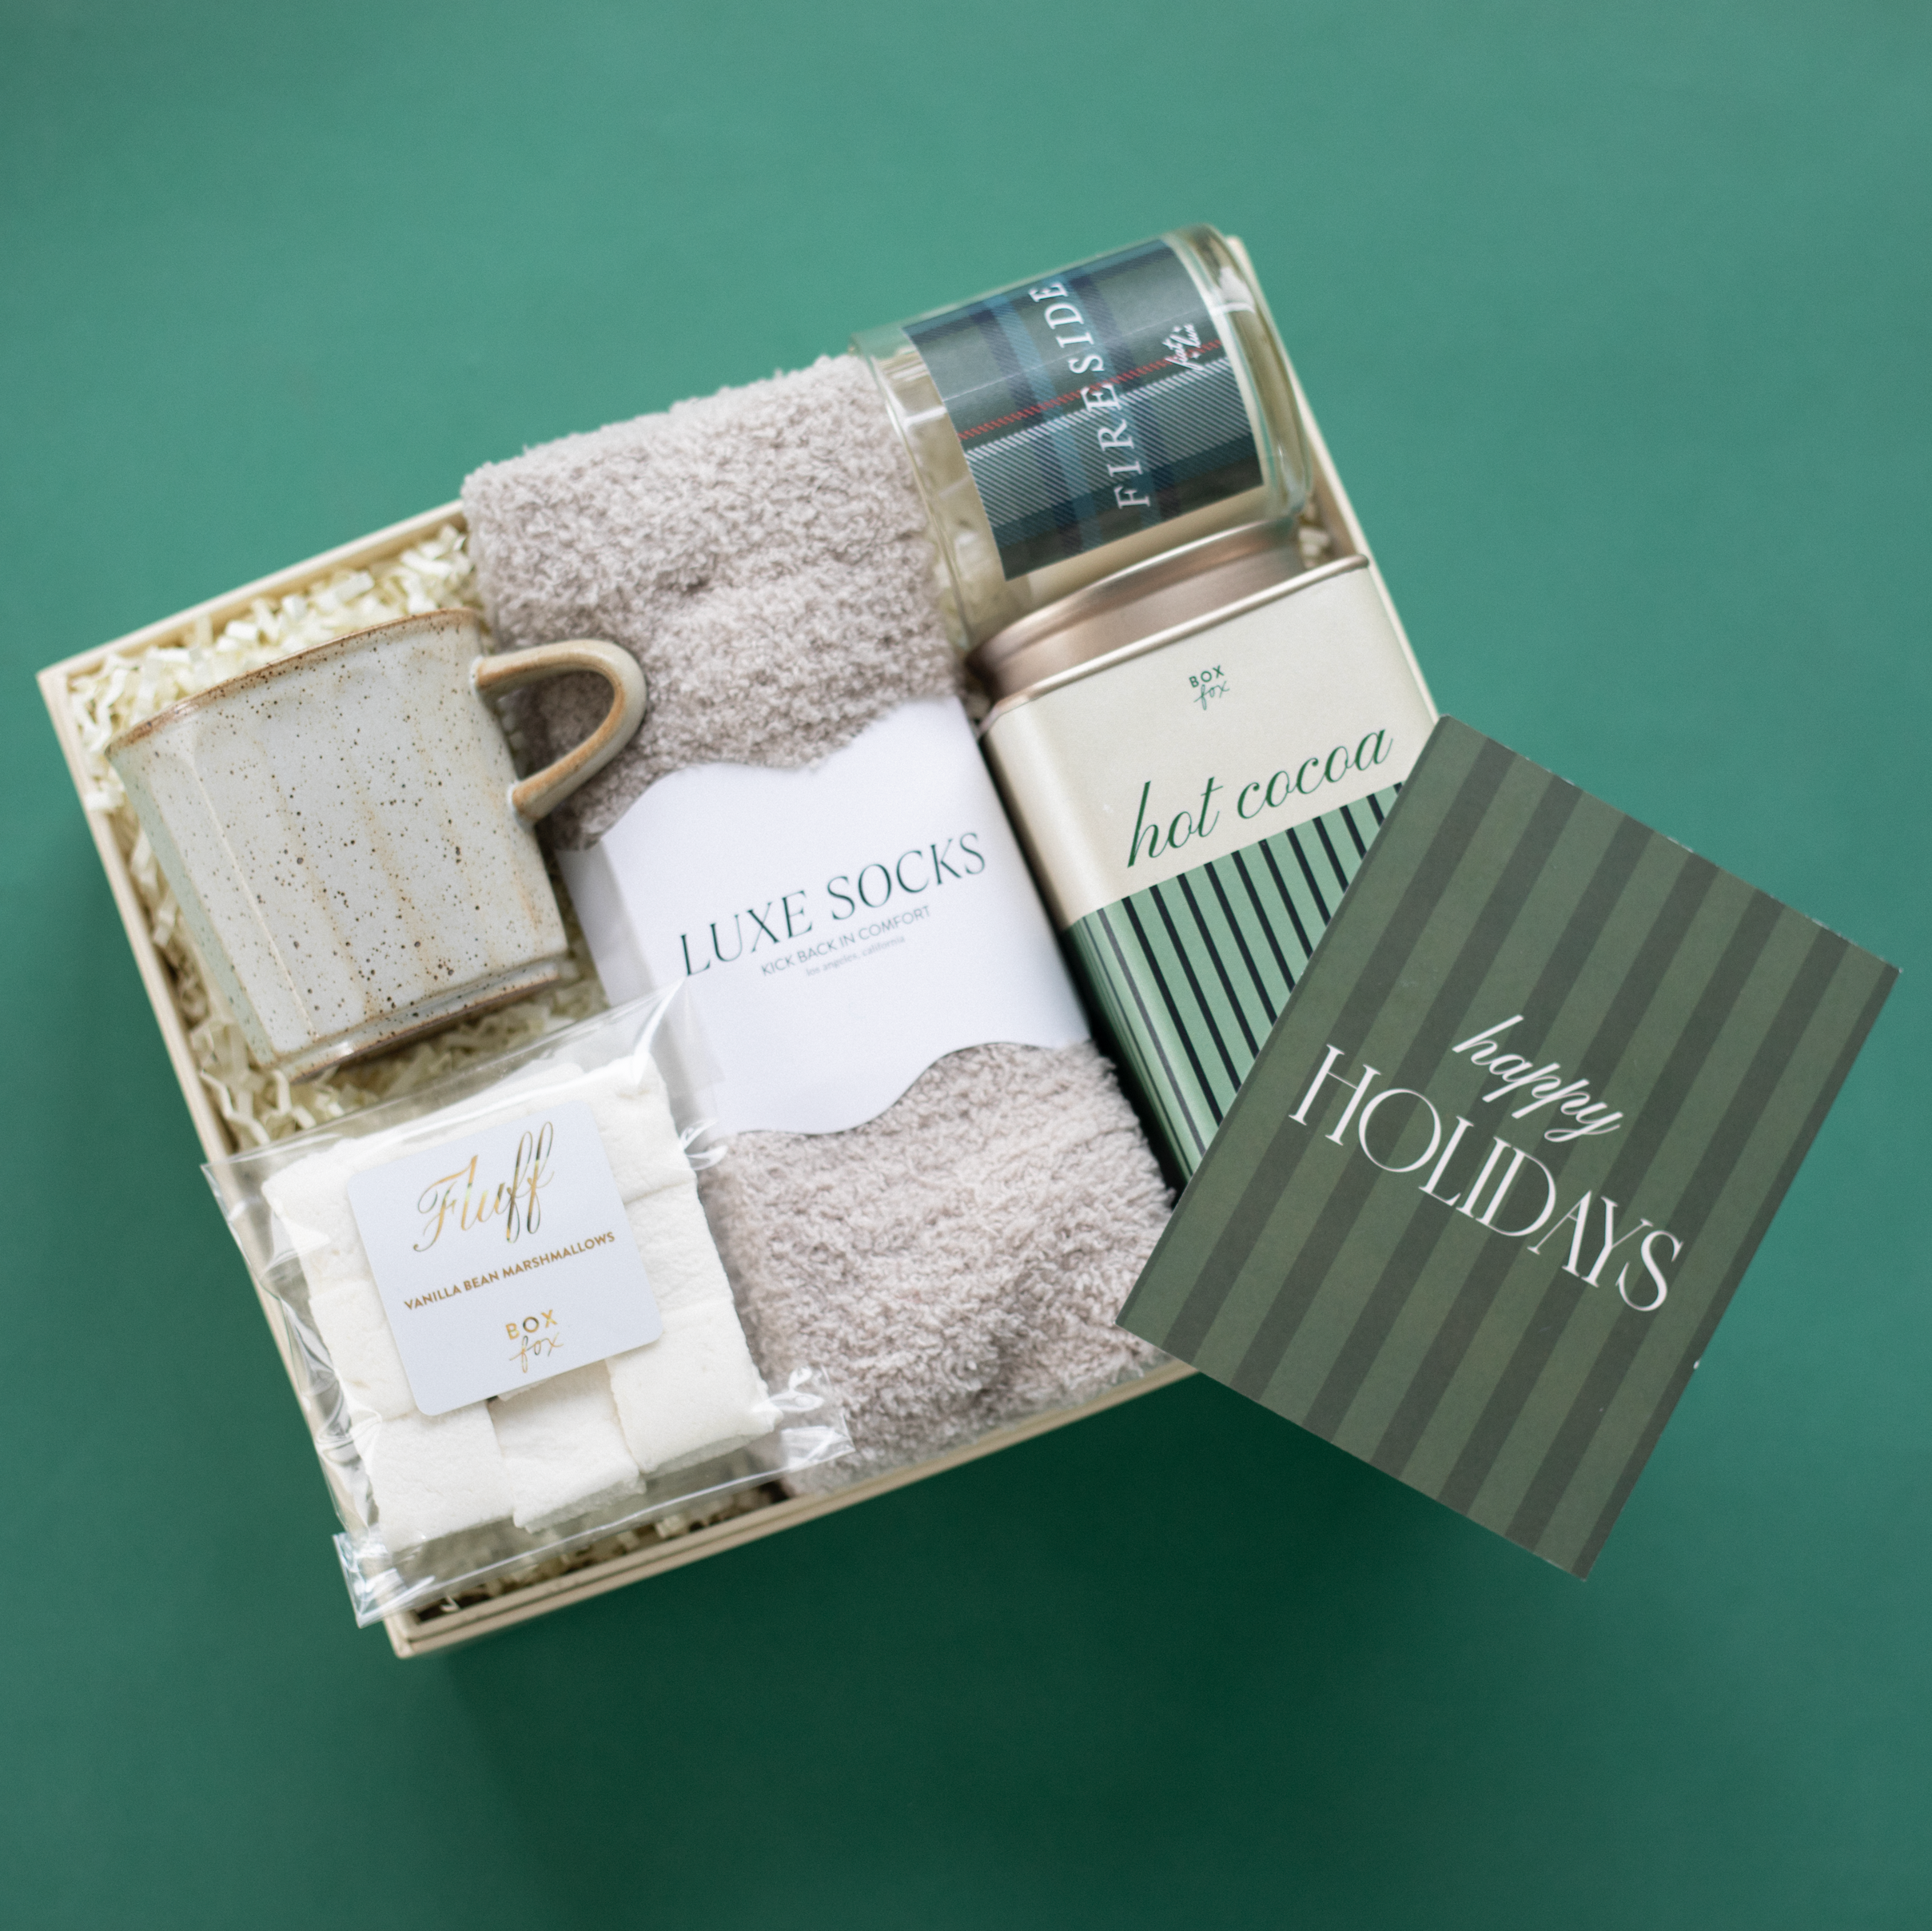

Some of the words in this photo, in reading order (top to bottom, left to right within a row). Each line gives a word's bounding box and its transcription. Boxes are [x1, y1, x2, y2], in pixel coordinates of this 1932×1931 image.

[1029, 281, 1151, 509] FIRESIDE
[1189, 665, 1225, 688] BOX
[1193, 680, 1231, 711] fox
[1127, 776, 1224, 869] hot
[1237, 729, 1394, 819] cocoa
[680, 890, 814, 977] LUXE
[827, 832, 986, 921] SOCKS
[761, 954, 795, 977] KICK
[796, 938, 838, 964] BACK
[839, 931, 856, 948] IN
[858, 904, 932, 942] COMFORT
[805, 966, 821, 977] los
[862, 934, 906, 960] california
[1452, 1014, 1623, 1143] happy
[412, 1121, 555, 1252] Fluff
[1288, 1044, 1683, 1312] HOLIDAYS
[404, 1284, 462, 1311] VANILLA
[463, 1270, 500, 1292] BEAN
[502, 1231, 615, 1279] MARSHMALLOWS
[505, 1309, 559, 1340] BOX
[509, 1332, 564, 1373] fox
